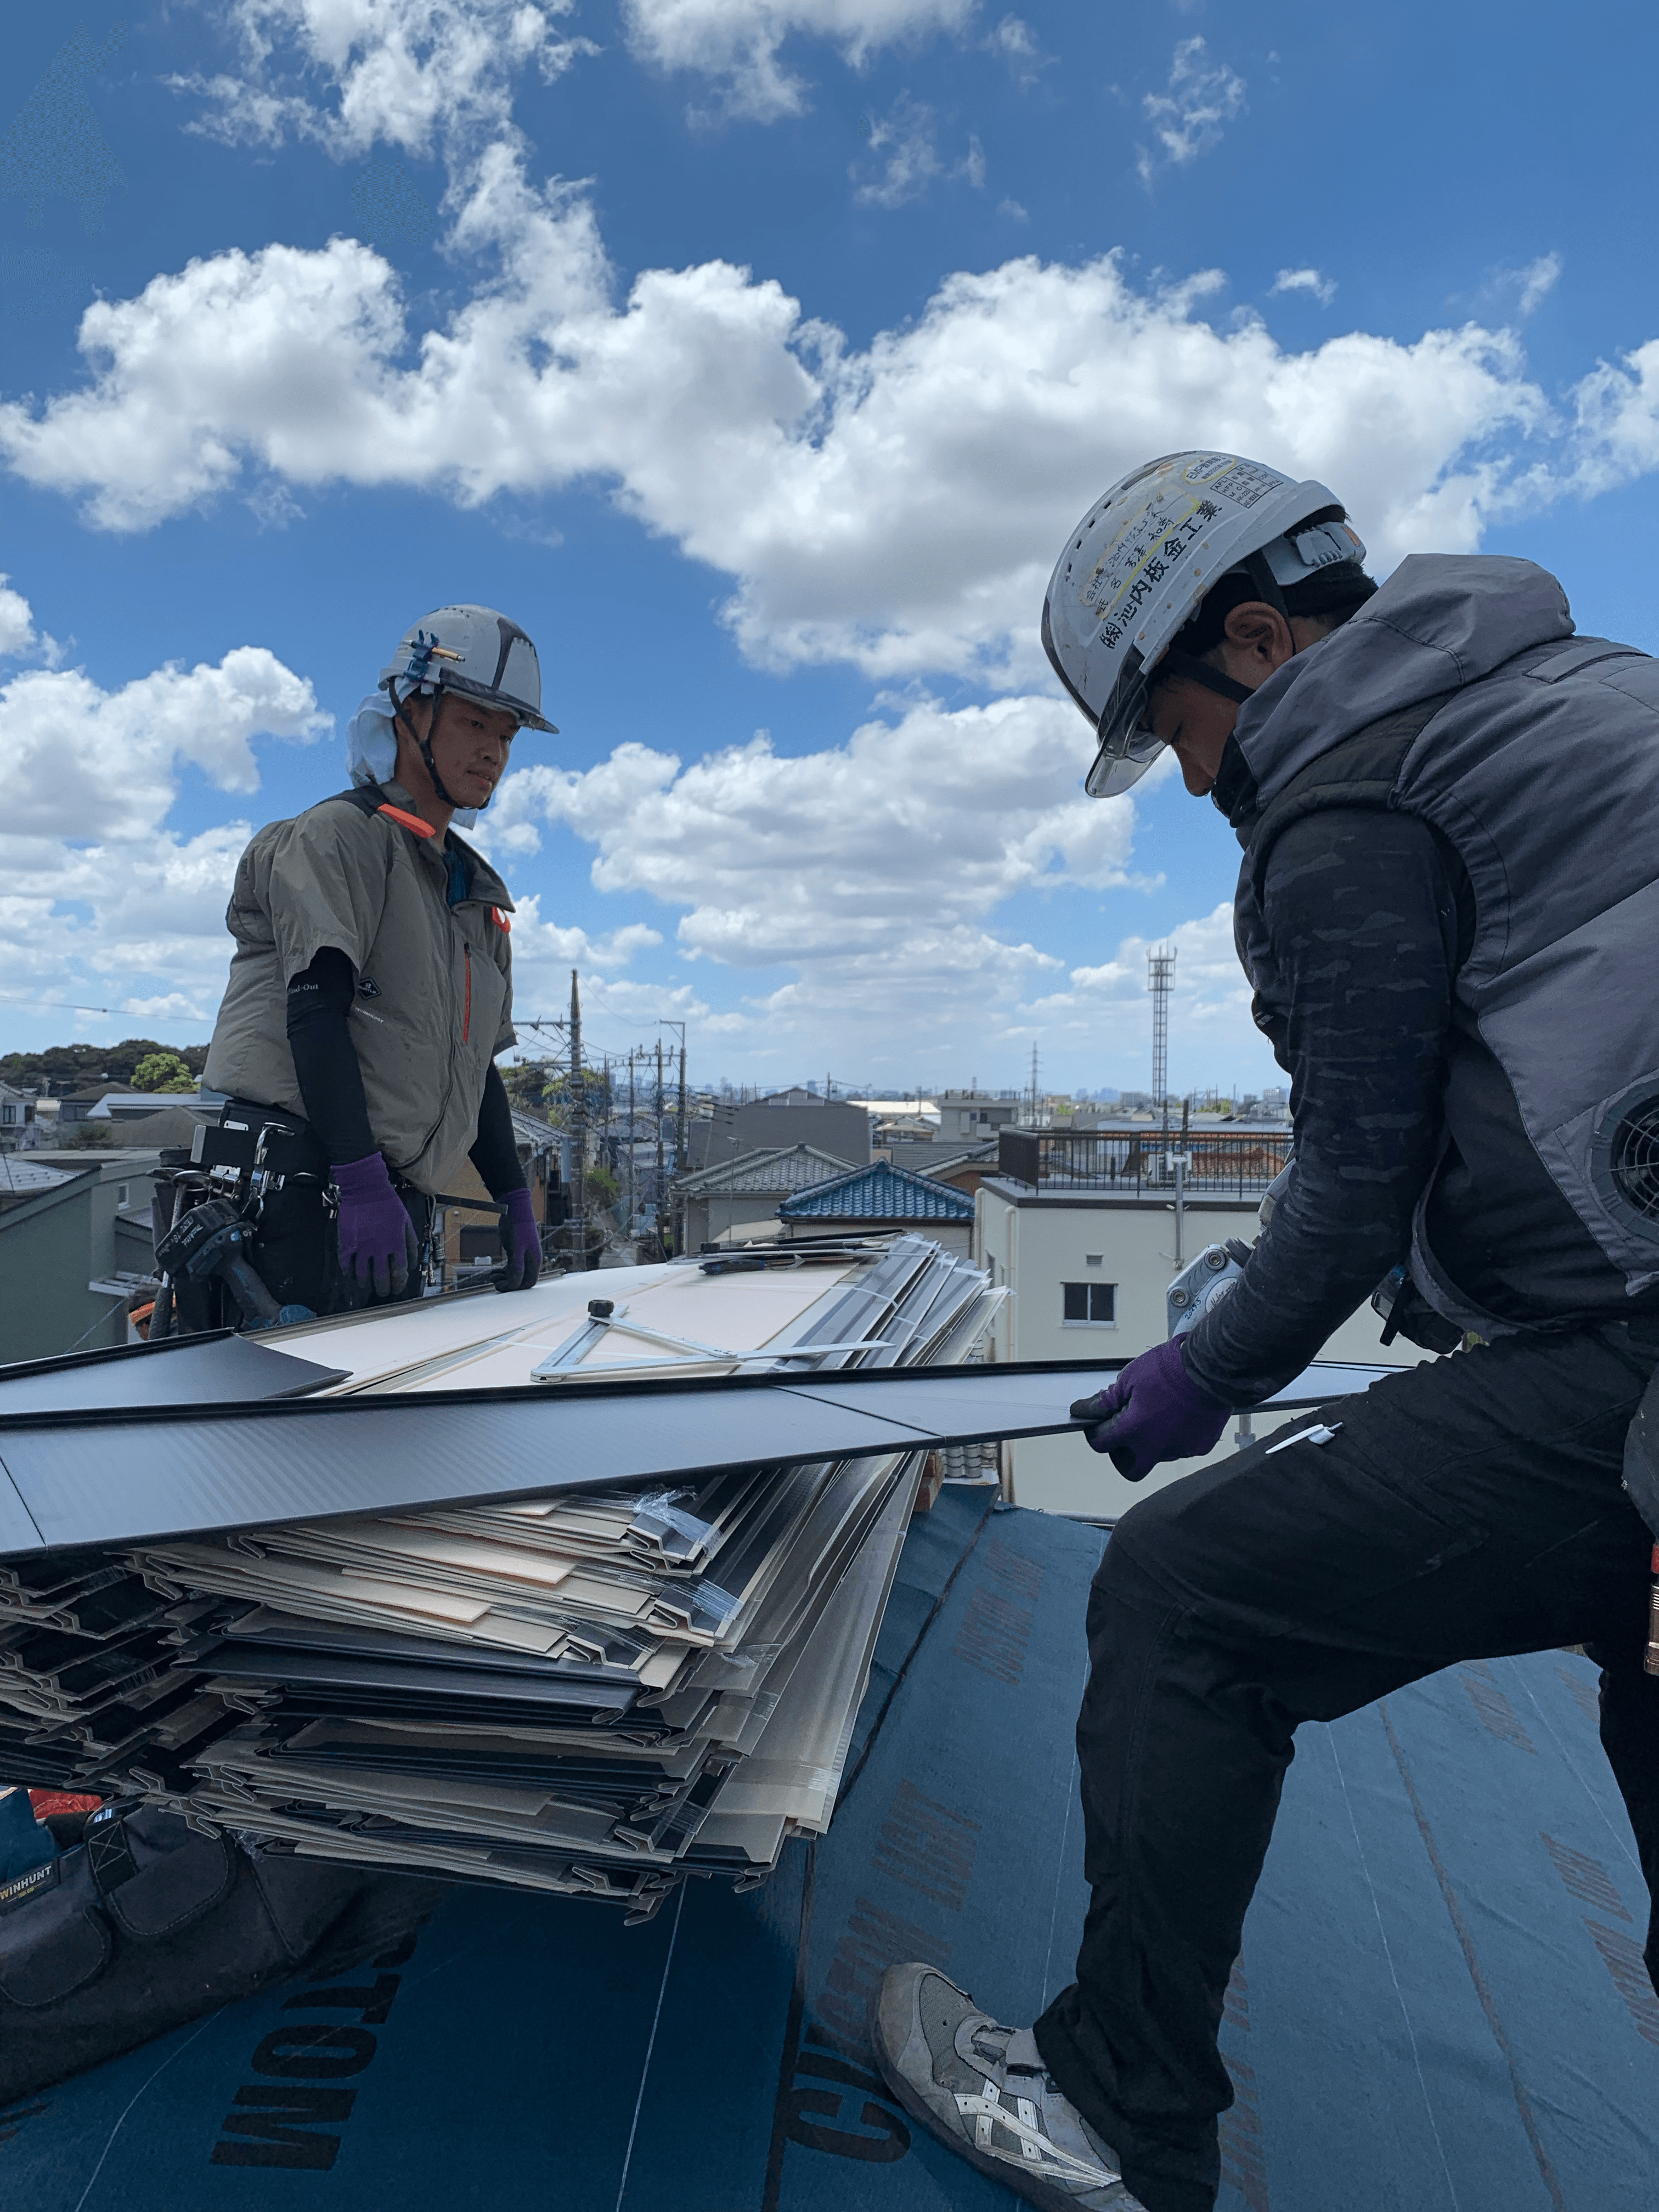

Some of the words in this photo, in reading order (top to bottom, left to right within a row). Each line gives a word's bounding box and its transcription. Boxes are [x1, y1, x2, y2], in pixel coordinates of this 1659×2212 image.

[1214, 478, 1227, 489] AFL
[1221, 481, 1234, 493] HFP
[1086, 568, 1113, 600] 会社
